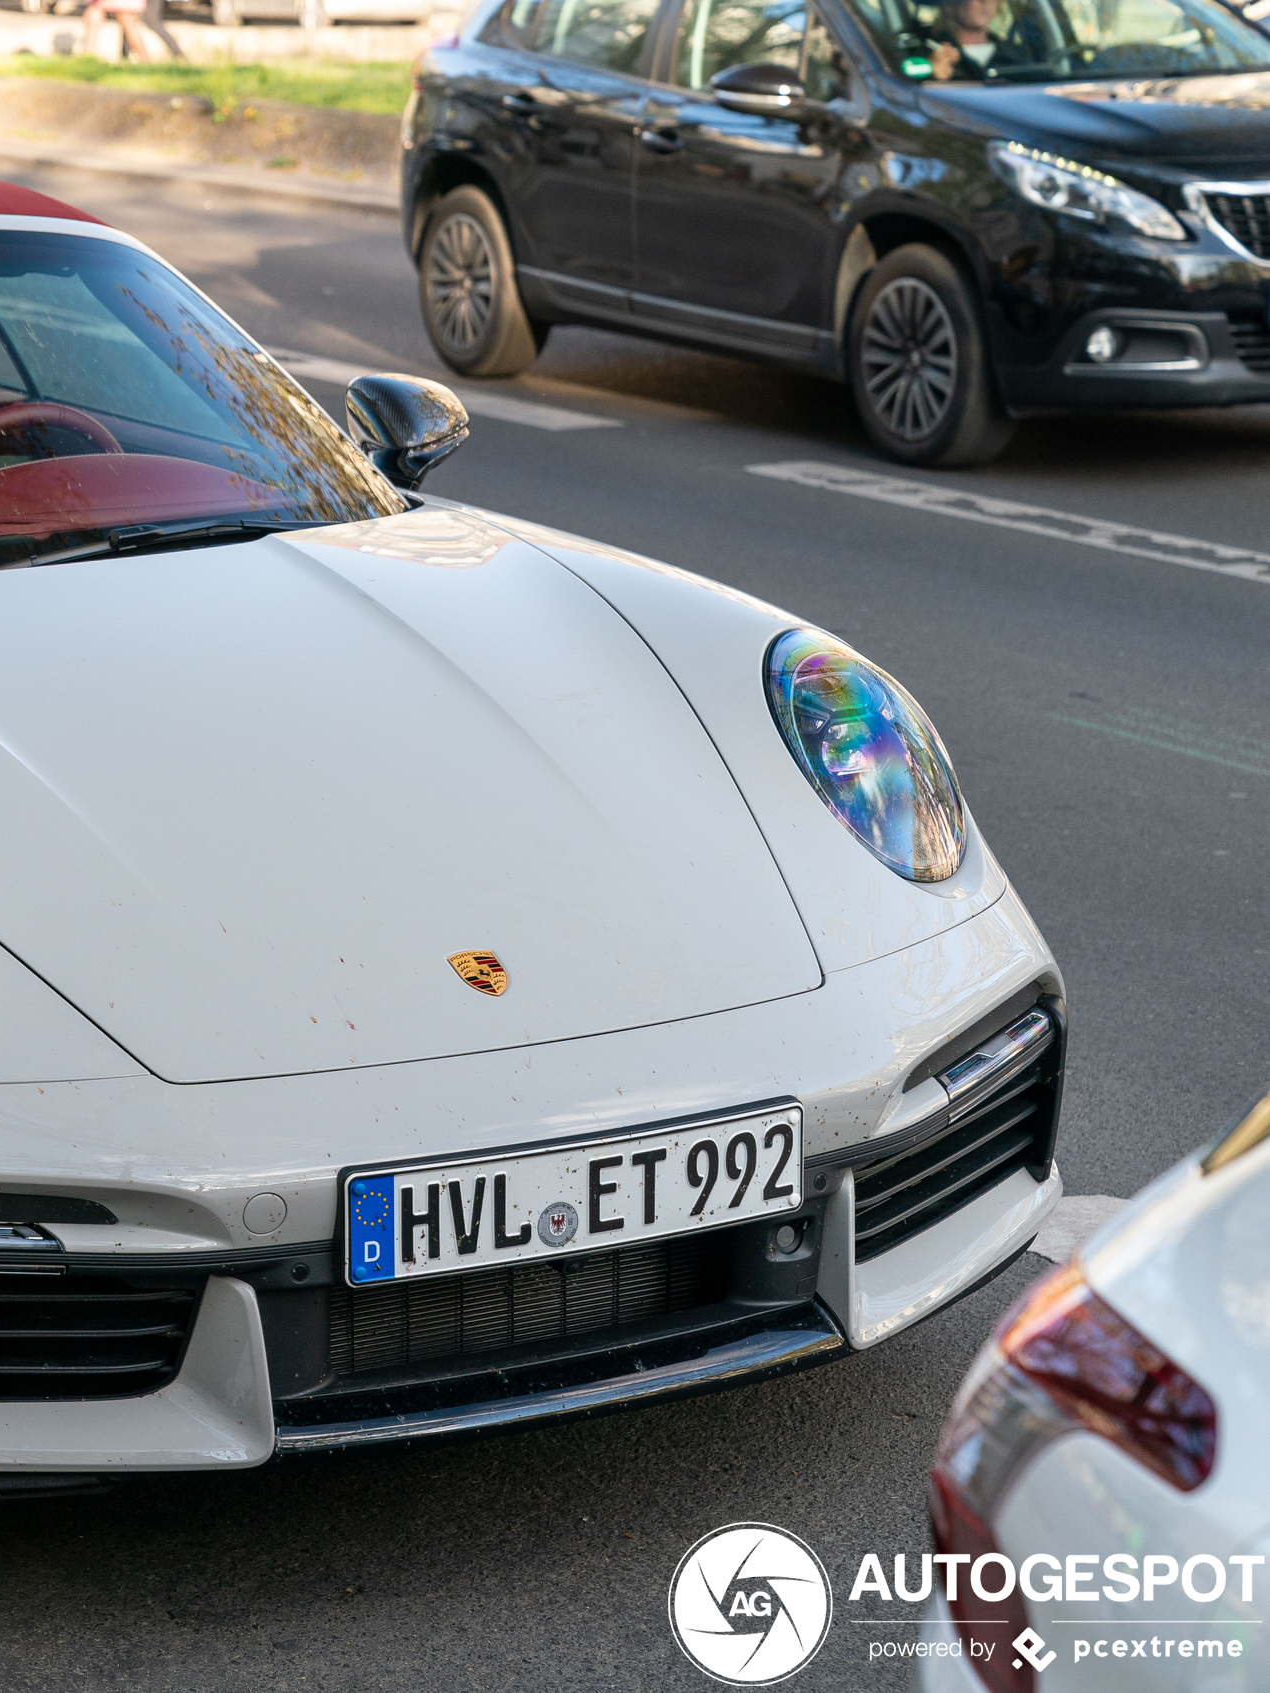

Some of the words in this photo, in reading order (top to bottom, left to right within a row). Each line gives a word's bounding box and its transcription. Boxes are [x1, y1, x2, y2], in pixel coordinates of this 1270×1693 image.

[449, 951, 494, 962] PORSCHE
[400, 1173, 532, 1264] HVL
[588, 1147, 668, 1235] ET
[686, 1124, 795, 1217] 992
[364, 1241, 381, 1263] D
